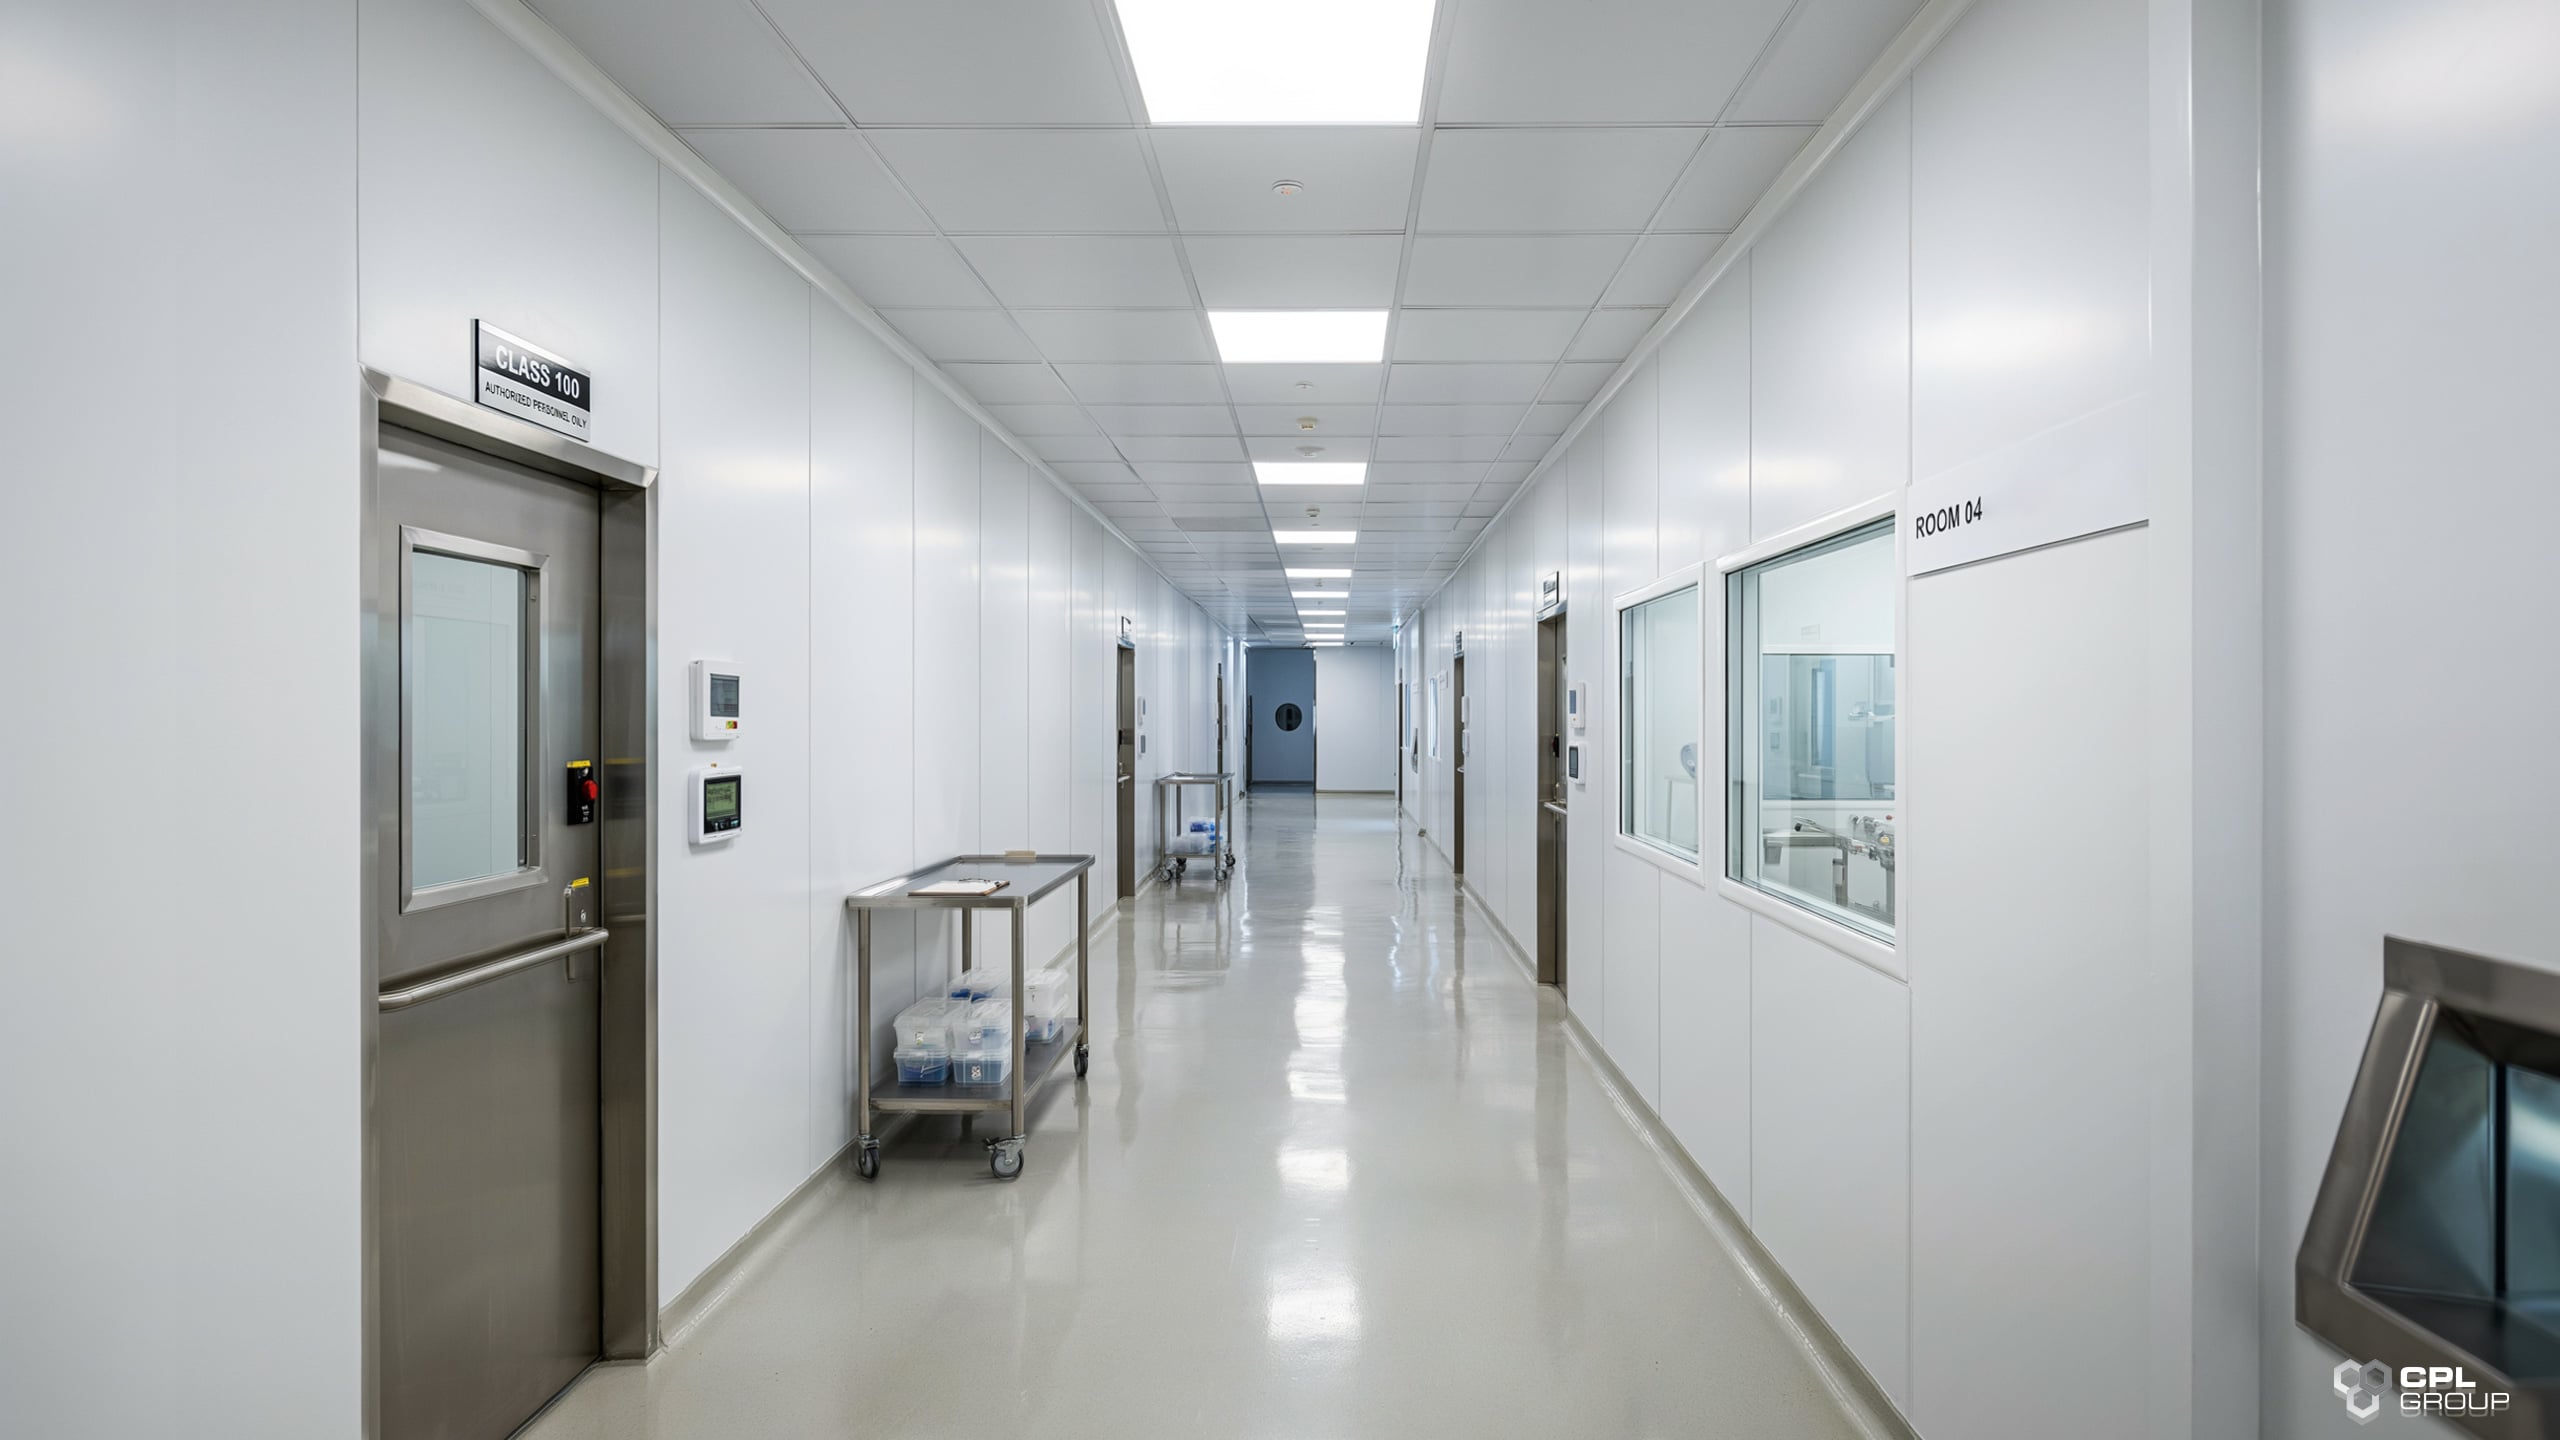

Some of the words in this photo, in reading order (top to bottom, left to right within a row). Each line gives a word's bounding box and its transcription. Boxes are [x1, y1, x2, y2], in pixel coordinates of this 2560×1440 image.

[495, 345, 551, 387] CLASS
[555, 371, 580, 399] 100
[533, 399, 571, 423] PERSONNEL
[1916, 504, 1960, 539] ROOM
[1965, 496, 1982, 524] 04
